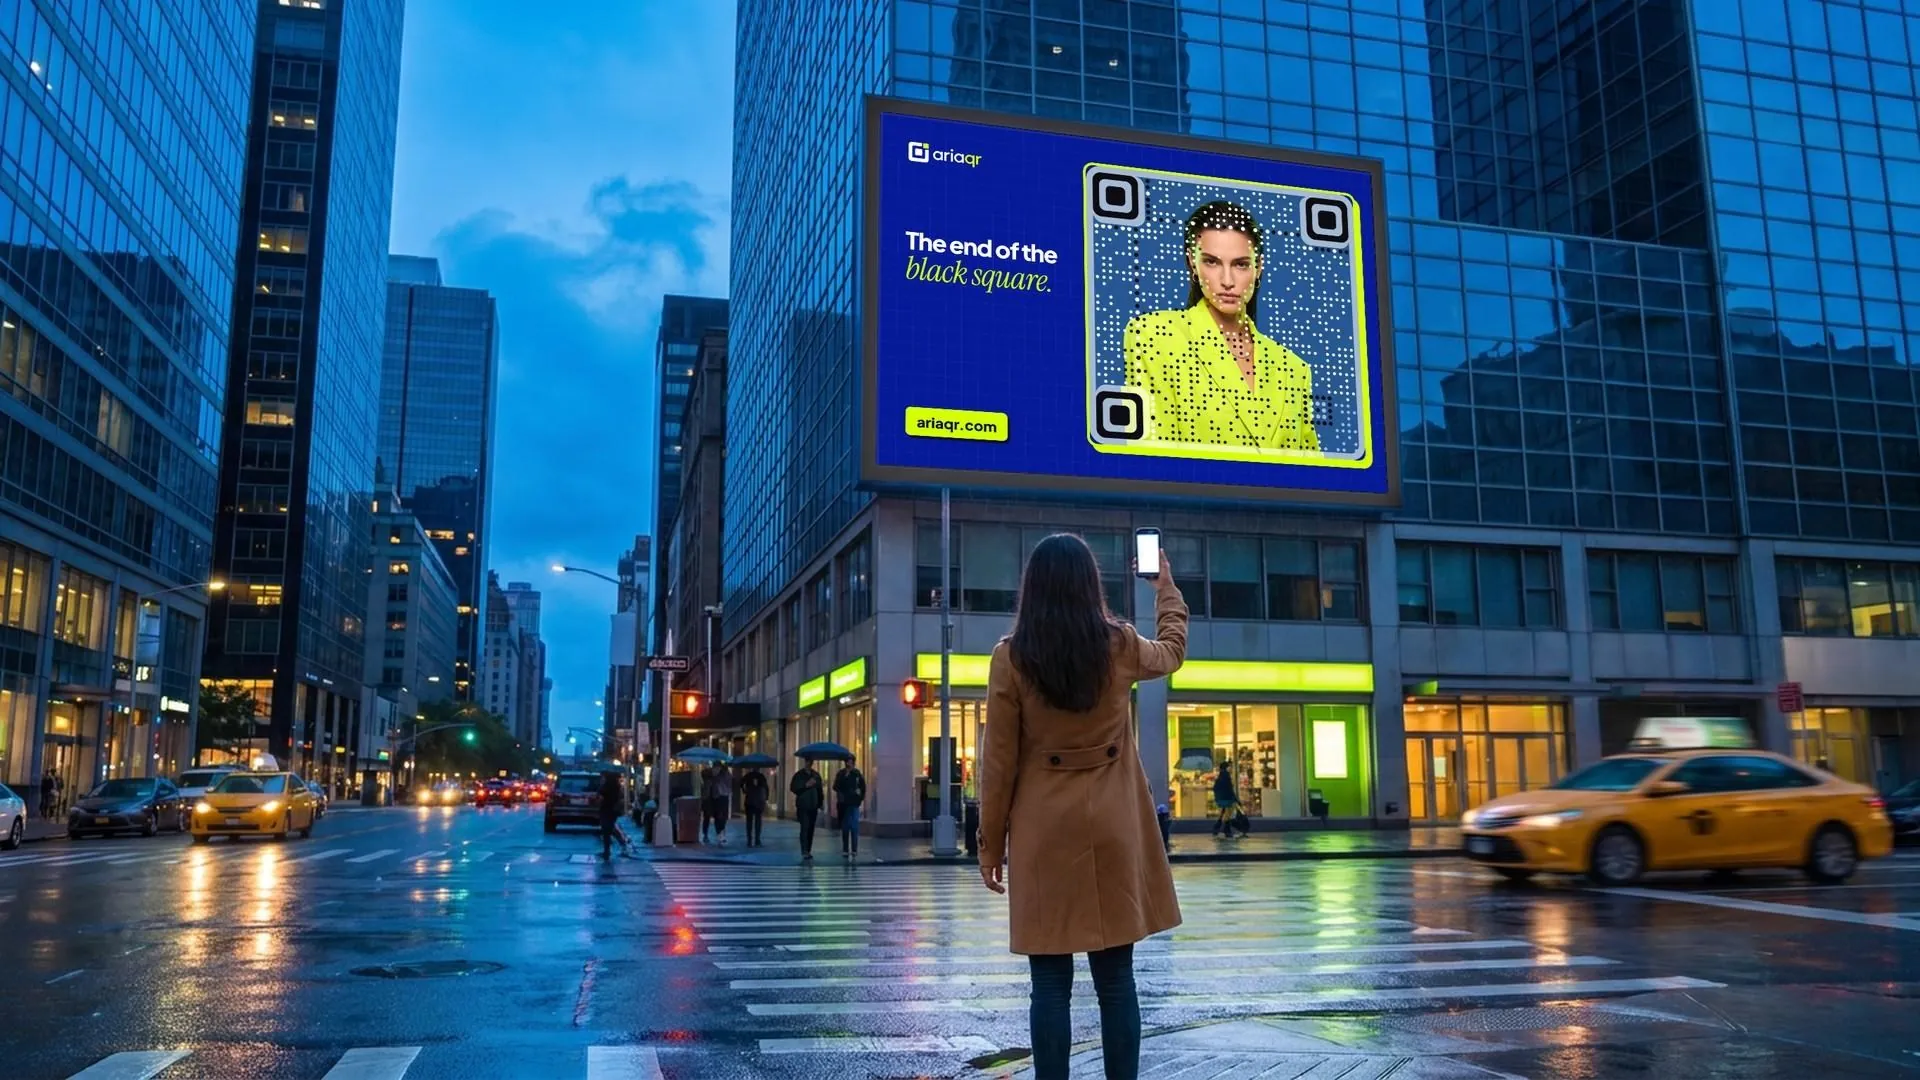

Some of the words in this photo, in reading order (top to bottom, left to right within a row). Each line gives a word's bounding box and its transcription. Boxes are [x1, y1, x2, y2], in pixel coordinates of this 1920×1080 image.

[932, 148, 982, 168] ariaqr
[905, 231, 947, 253] The
[949, 239, 993, 258] end
[995, 242, 1020, 260] of
[1021, 244, 1058, 264] the
[906, 255, 967, 285] black
[971, 268, 1052, 293] square.
[916, 417, 997, 433] ariaqr.com
